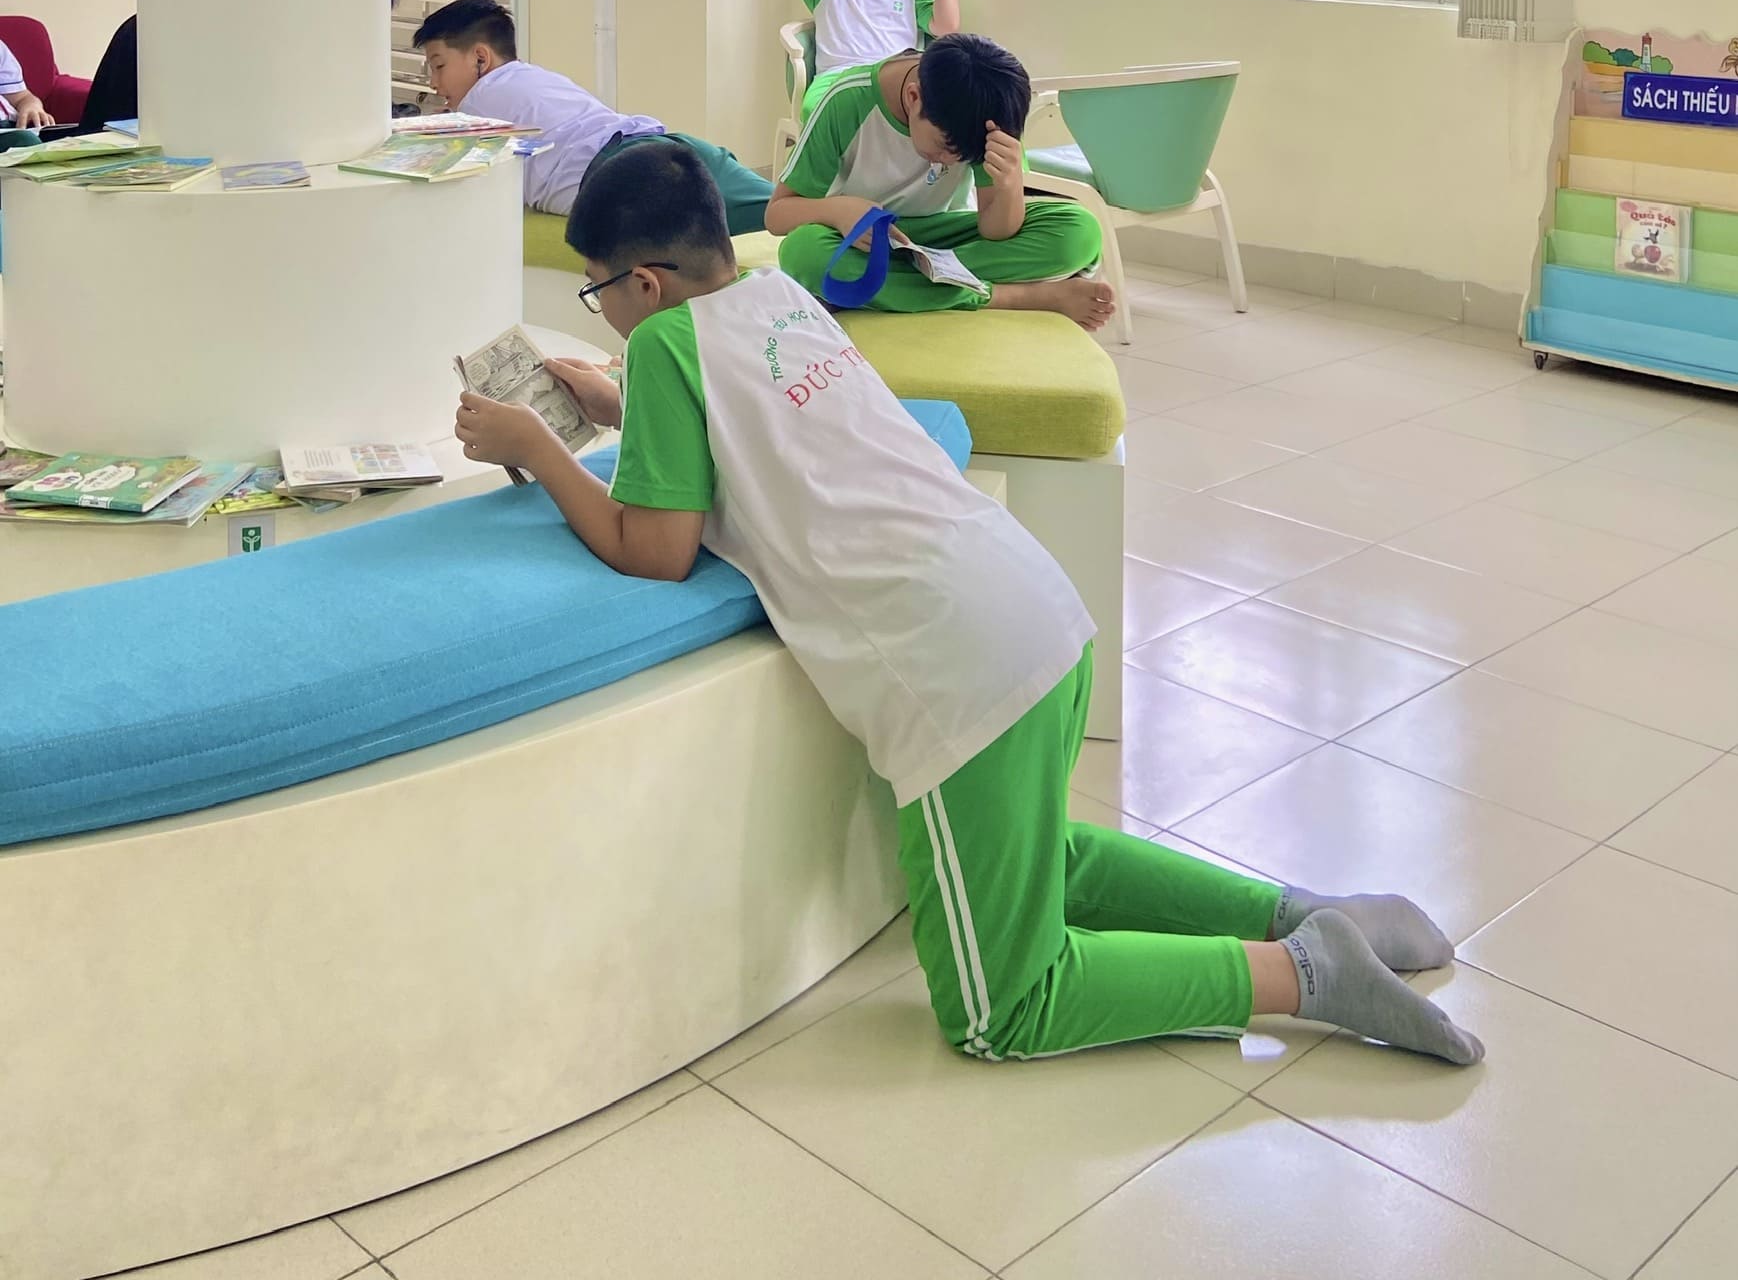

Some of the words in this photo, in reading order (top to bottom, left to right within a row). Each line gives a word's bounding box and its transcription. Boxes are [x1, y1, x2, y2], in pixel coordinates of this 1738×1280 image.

[1632, 82, 1678, 110] SÁCH
[1682, 85, 1730, 115] THIẾU
[784, 359, 843, 408] ĐỨC
